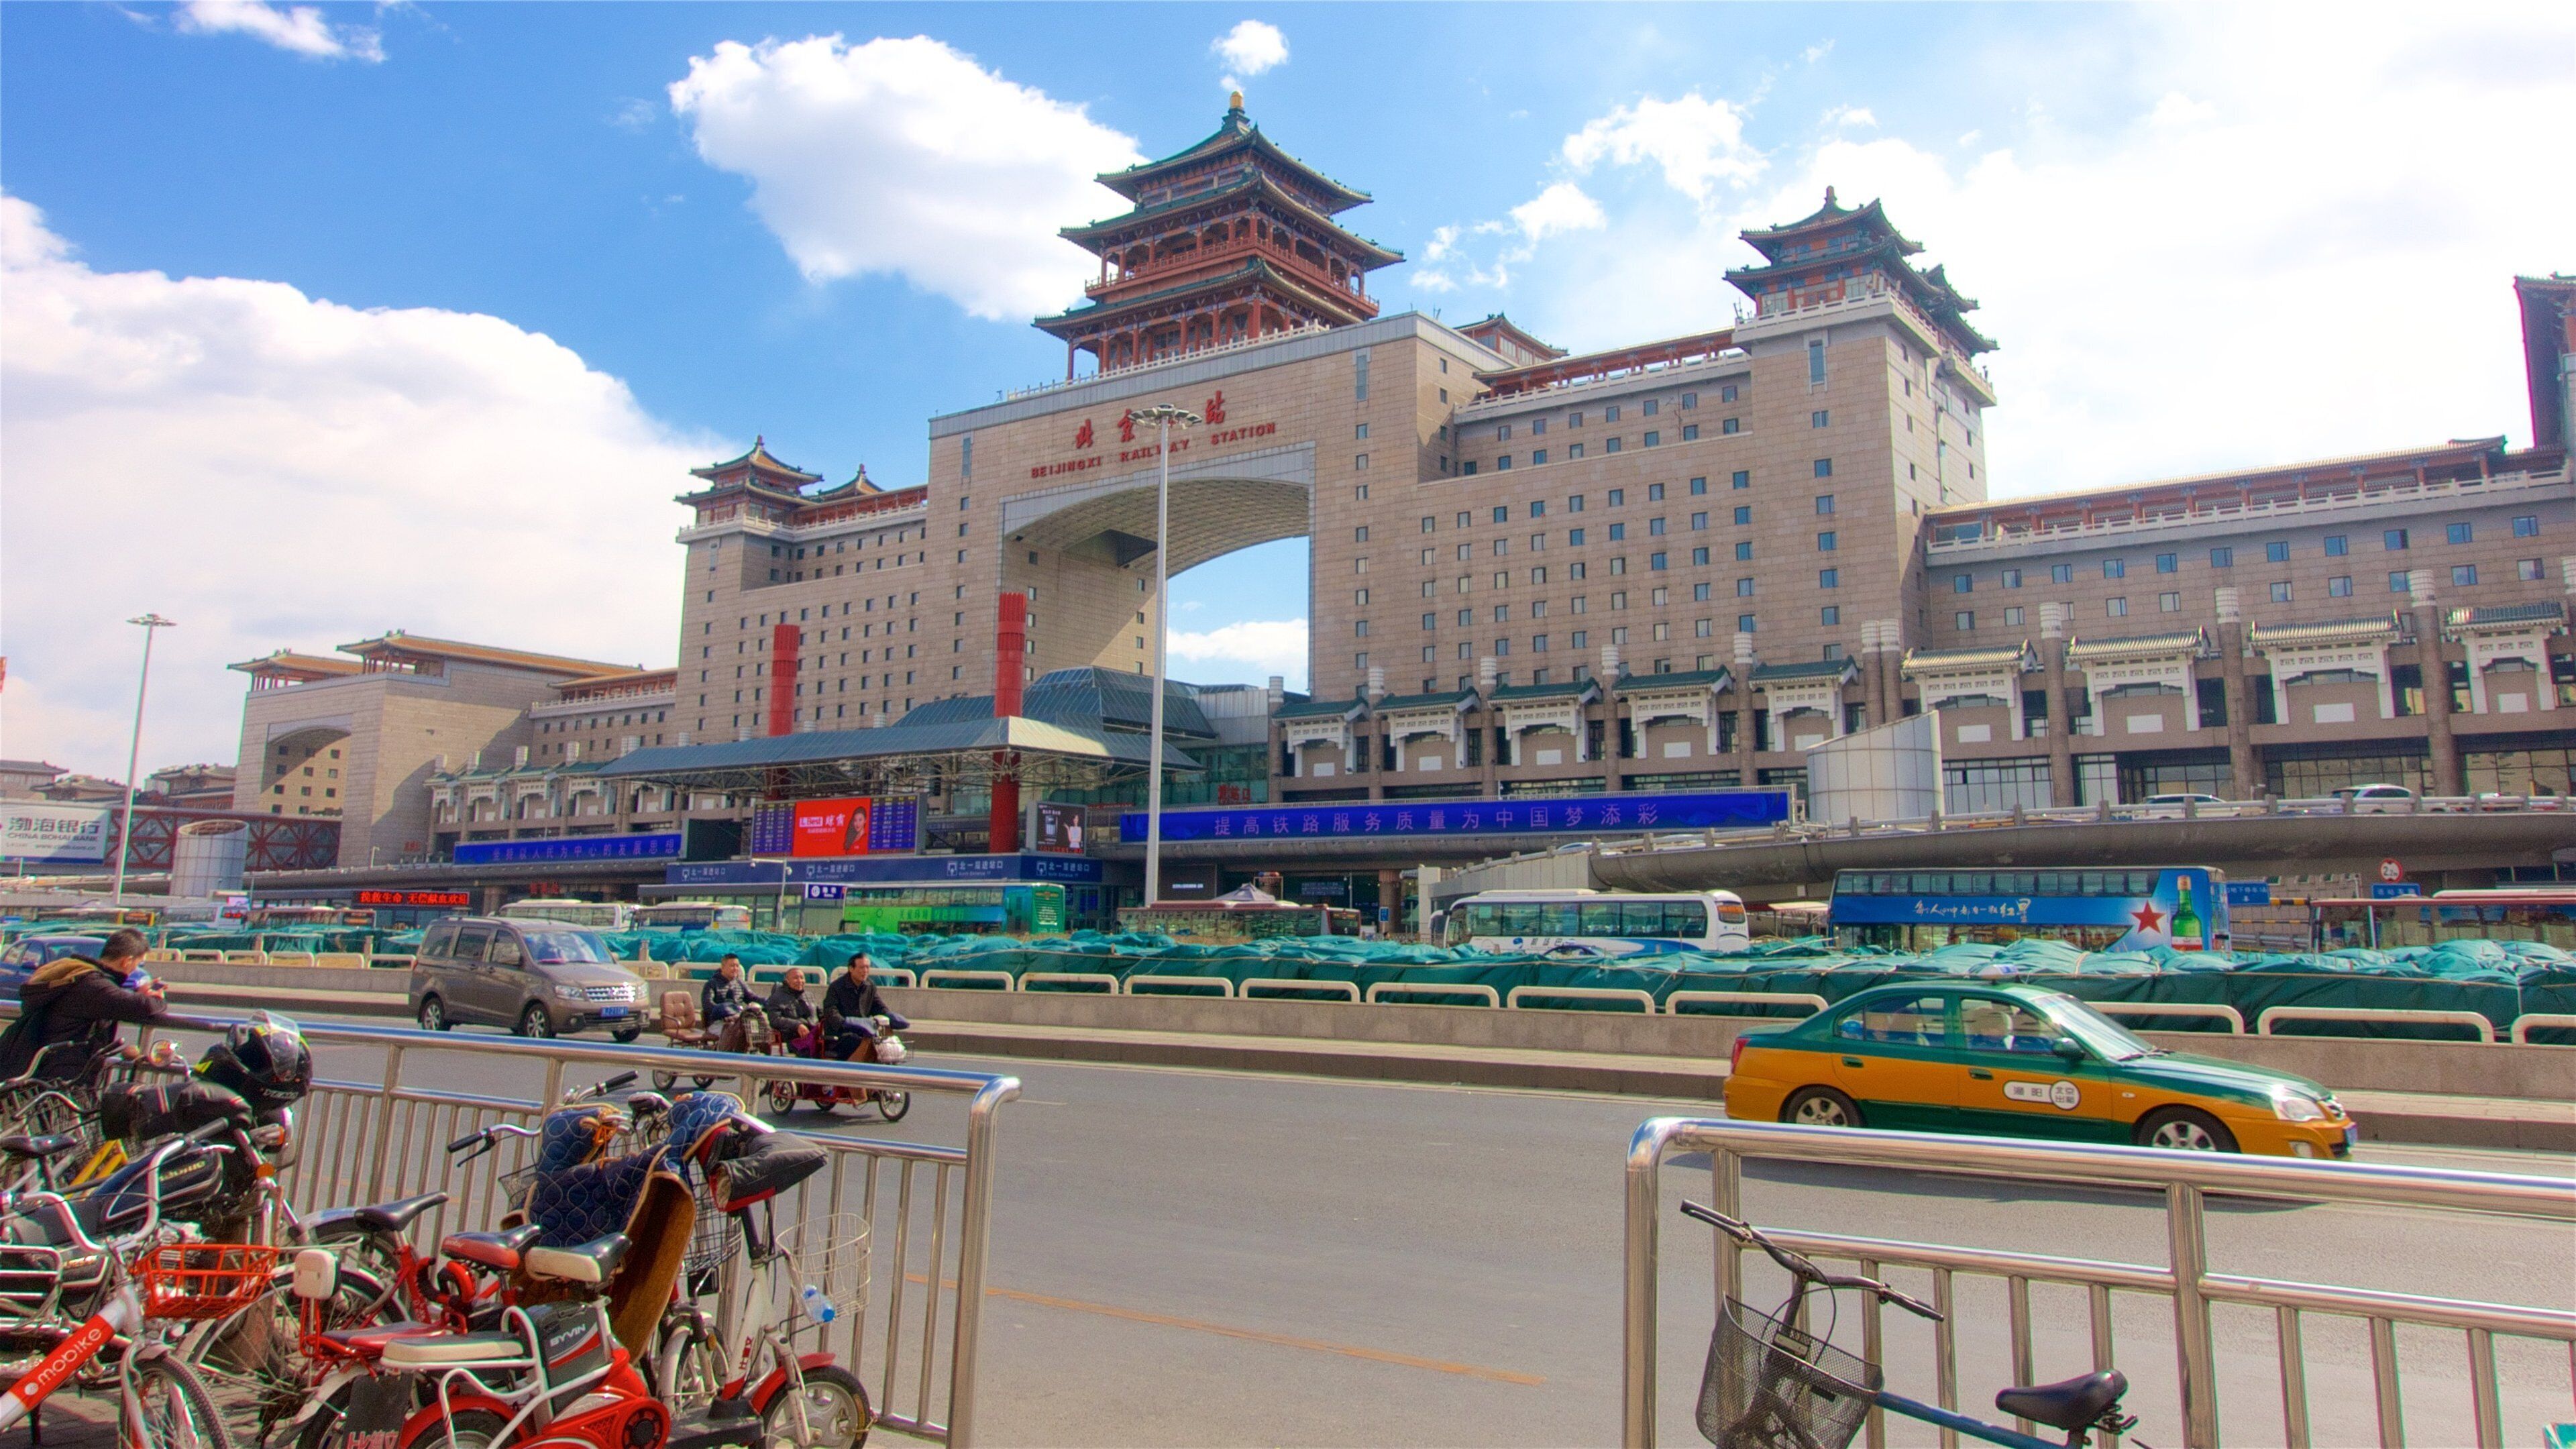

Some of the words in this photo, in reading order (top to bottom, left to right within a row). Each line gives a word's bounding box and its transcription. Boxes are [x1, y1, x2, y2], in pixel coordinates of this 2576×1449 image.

[1075, 390, 1226, 449] 北京站
[1031, 455, 1102, 478] BEIJINGXI
[1210, 422, 1276, 445] STATION
[9, 817, 100, 834] 渤海银行
[1214, 804, 1659, 836] 提高铁路服务质量为中国梦添彩
[2055, 1087, 2074, 1095] 北京
[550, 1324, 586, 1347] BYVIN
[37, 1328, 102, 1386] mobike
